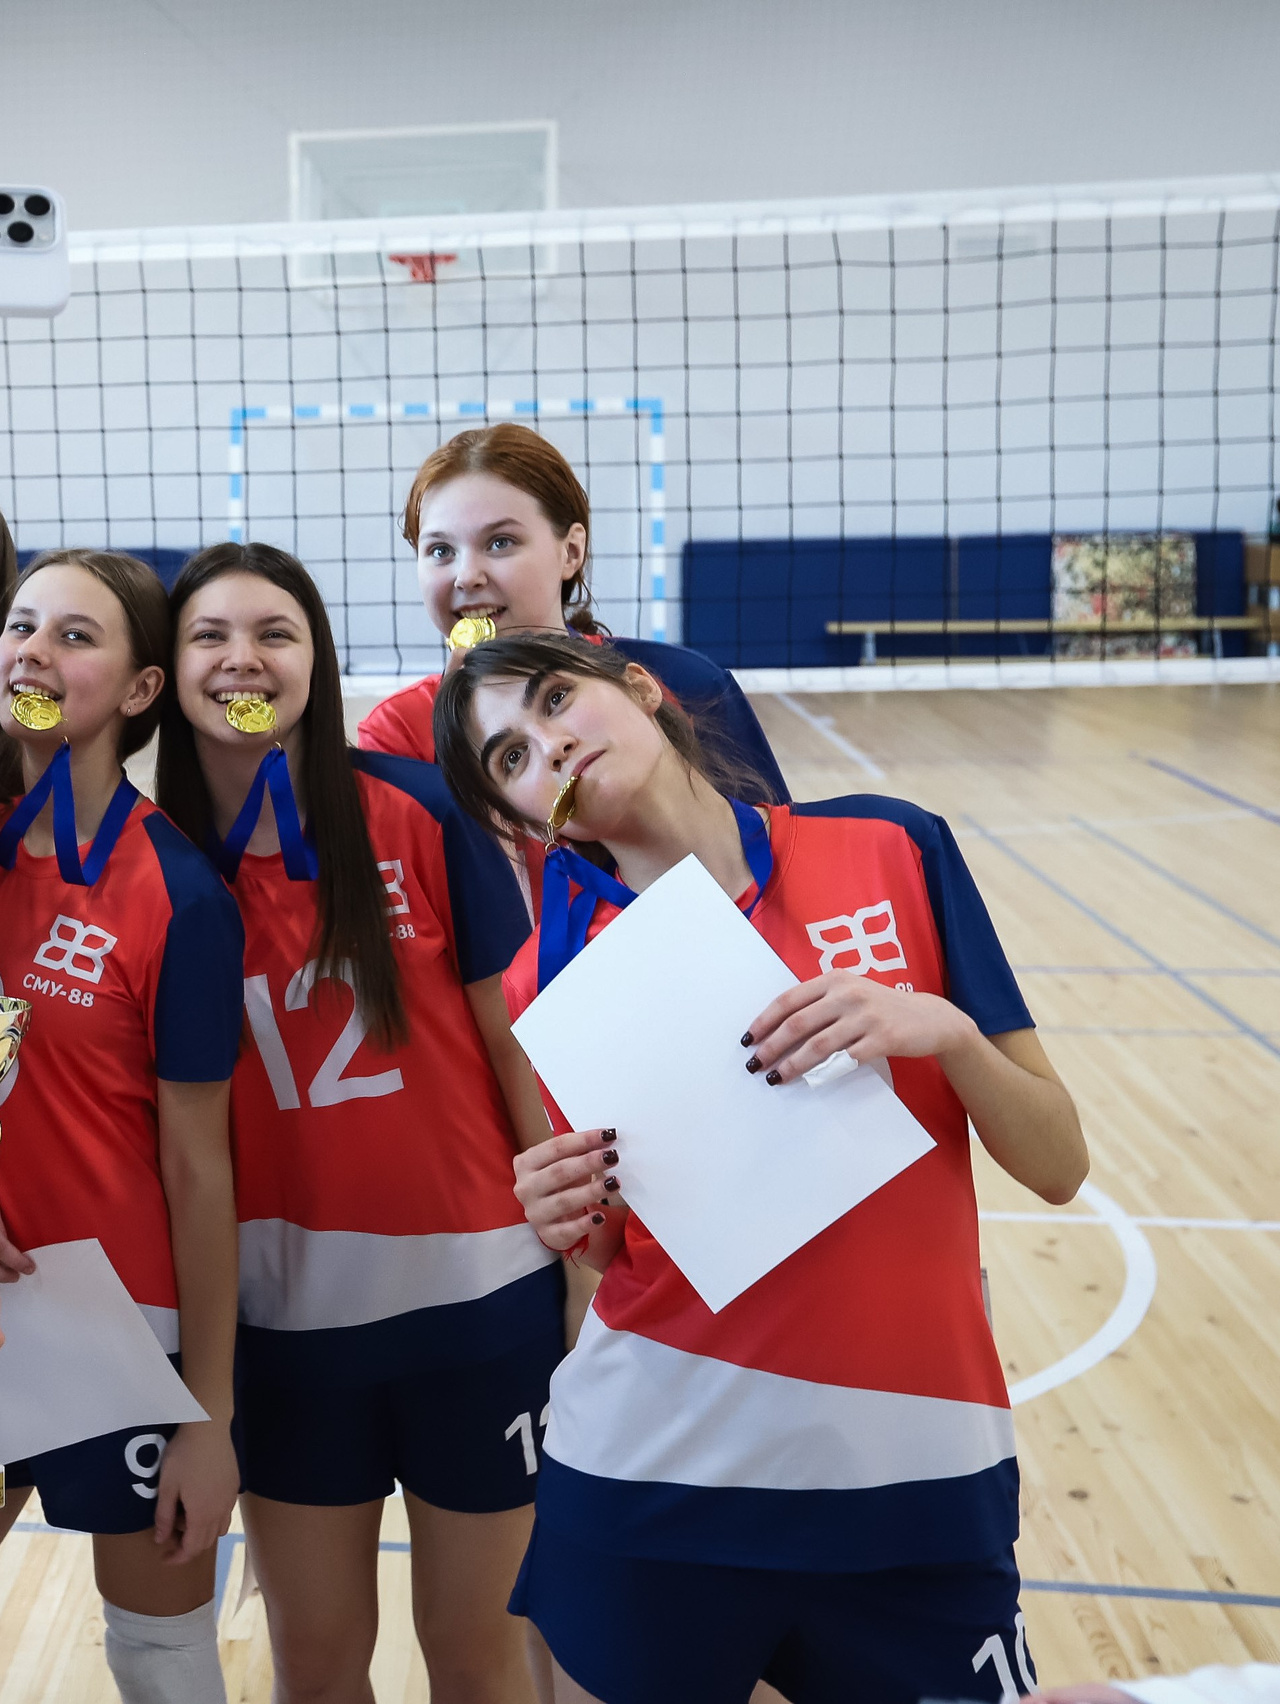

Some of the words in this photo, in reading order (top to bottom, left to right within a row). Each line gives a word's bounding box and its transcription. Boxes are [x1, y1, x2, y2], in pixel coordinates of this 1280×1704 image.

[23, 973, 95, 1008] СМУ-88
[243, 957, 405, 1111] 12
[124, 1433, 168, 1499] 9
[504, 1402, 551, 1476] 1
